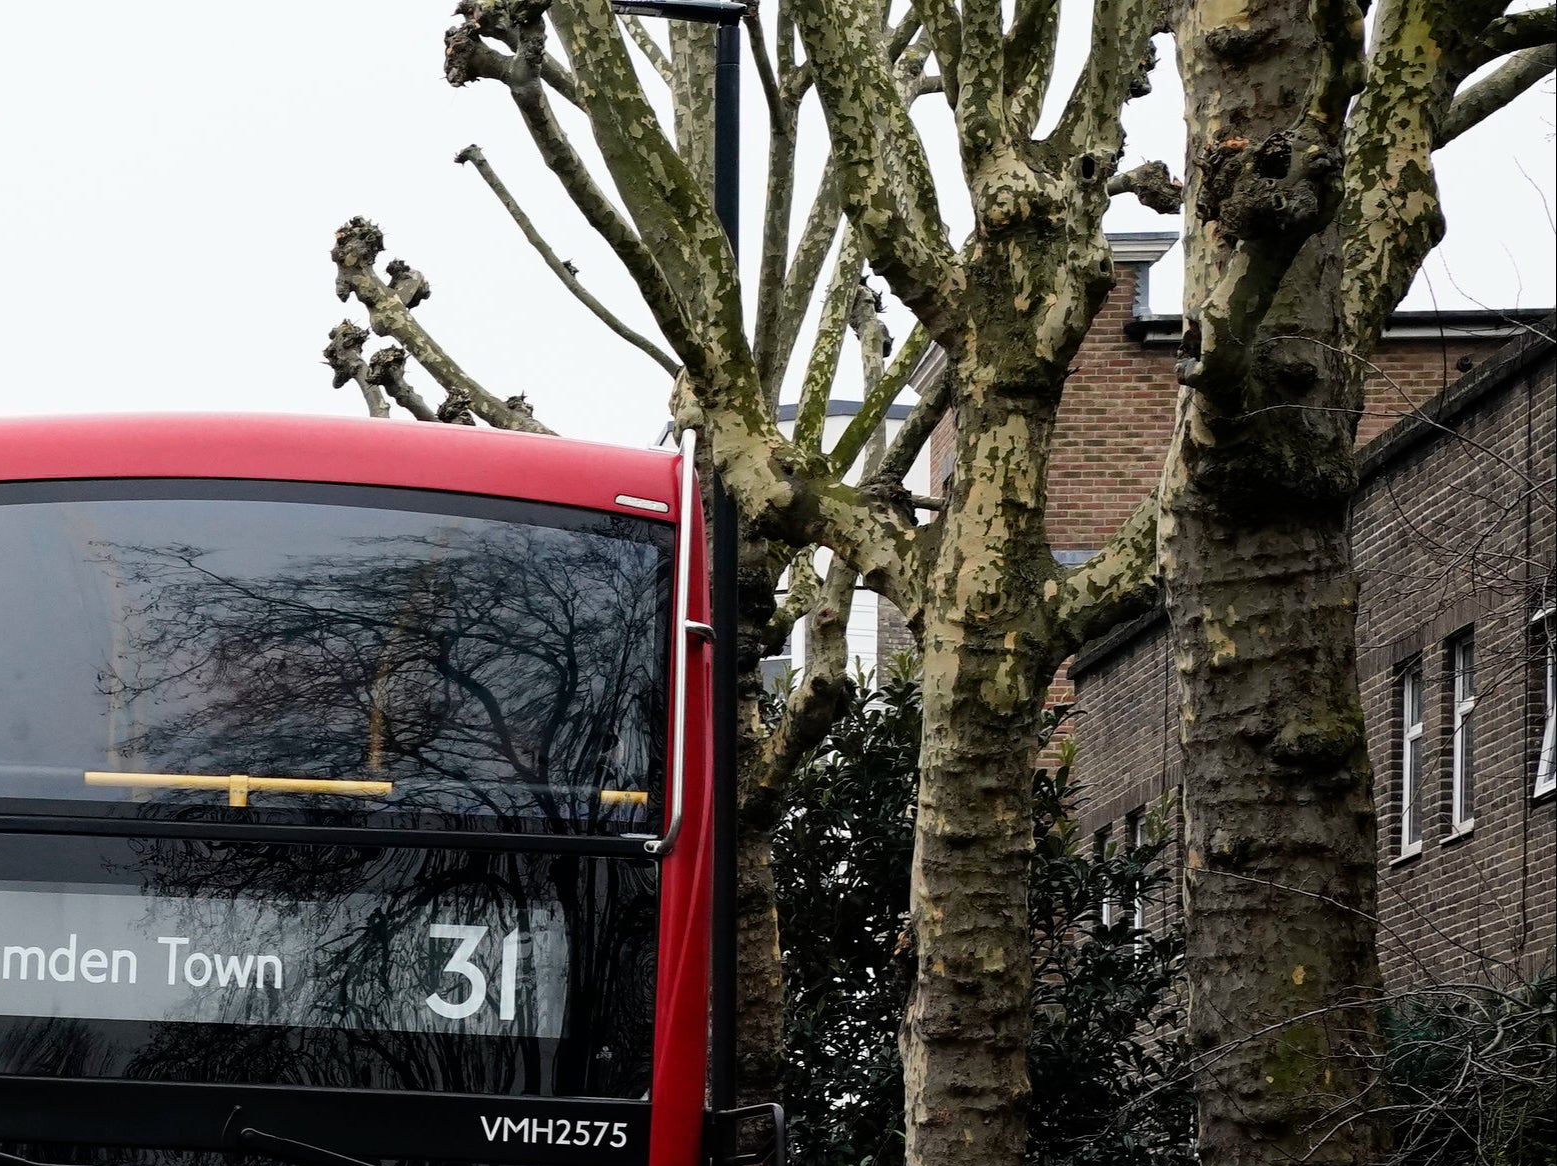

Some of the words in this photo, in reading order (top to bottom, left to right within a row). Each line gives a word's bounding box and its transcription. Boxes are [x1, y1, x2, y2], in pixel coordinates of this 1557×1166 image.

[157, 935, 283, 990] Town
[425, 923, 519, 1022] 31
[480, 1115, 628, 1148] VMH2575
